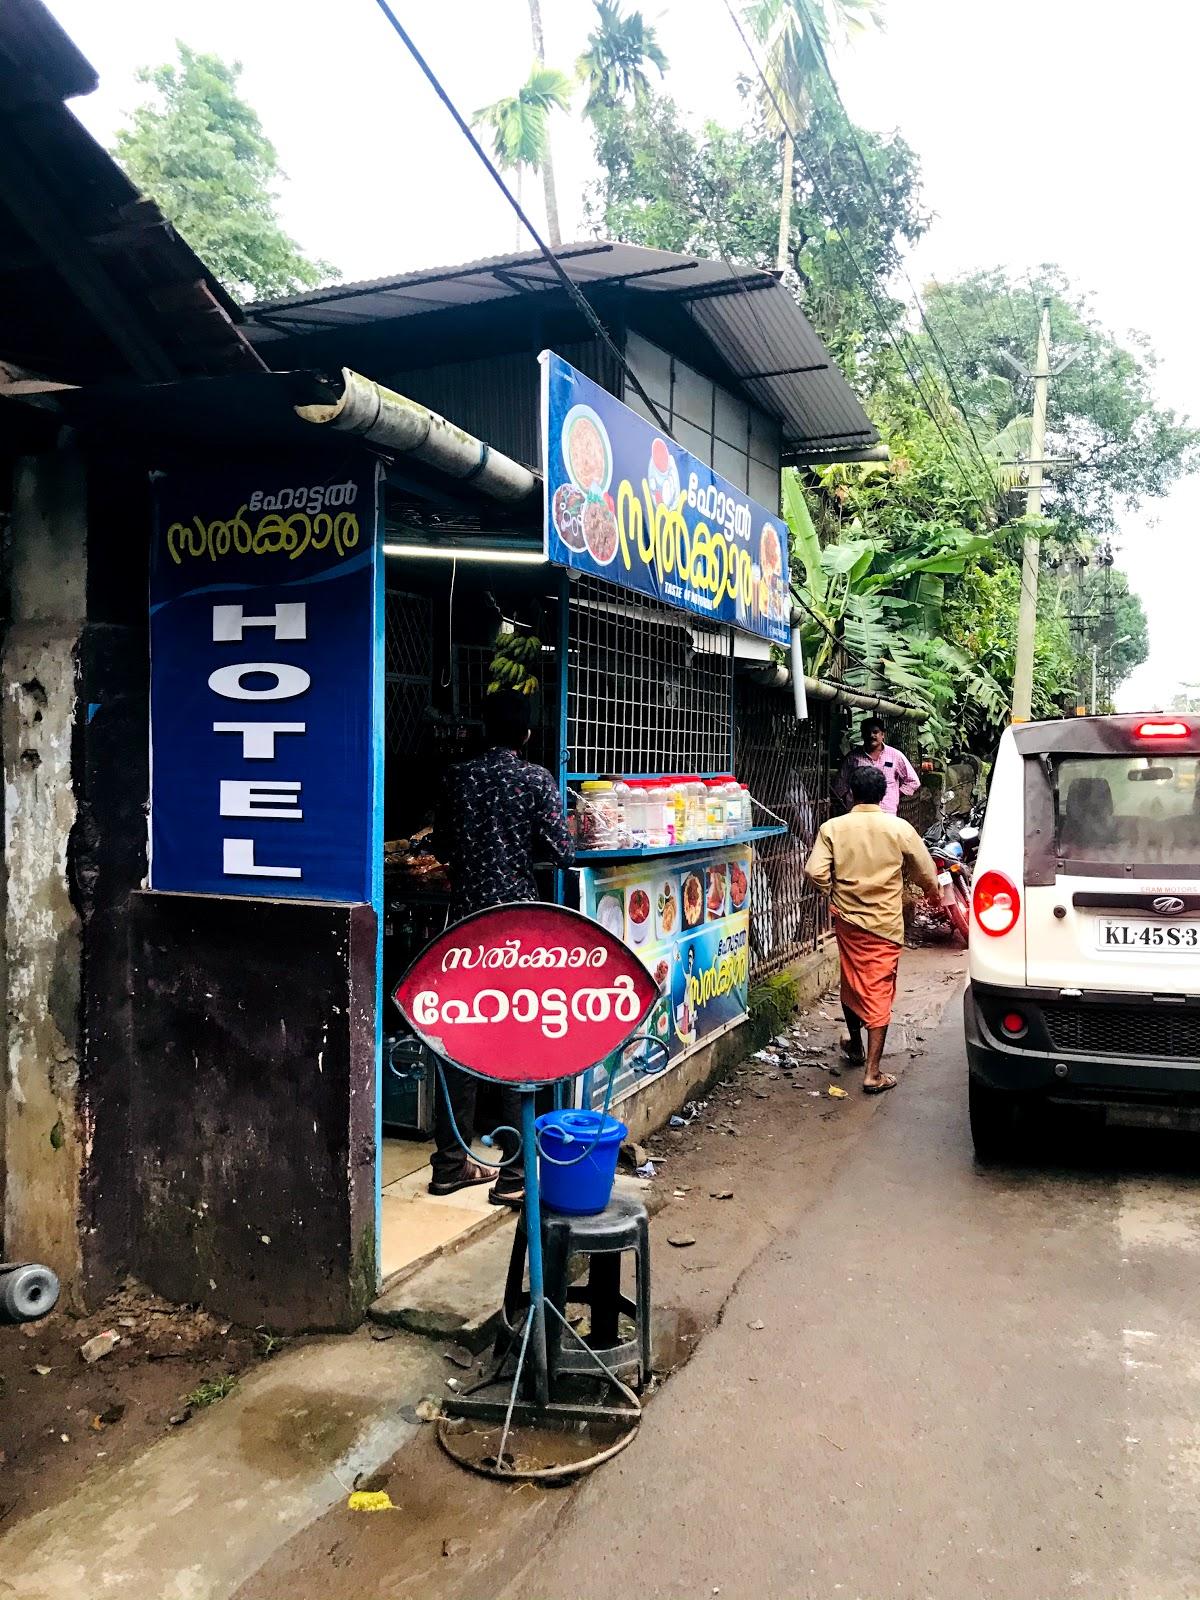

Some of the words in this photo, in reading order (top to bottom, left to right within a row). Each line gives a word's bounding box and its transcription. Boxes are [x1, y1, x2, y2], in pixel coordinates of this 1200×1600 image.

[249, 480, 358, 515] ഹോട്ടൽ
[687, 472, 752, 542] ഹോട്ടൽ
[167, 504, 360, 564] സൽക്കാര
[664, 581, 683, 599] TASTE
[208, 602, 311, 877] HOTEL
[441, 939, 608, 973] സൽക്കാര
[412, 974, 641, 1039] ഹോട്ടൽ
